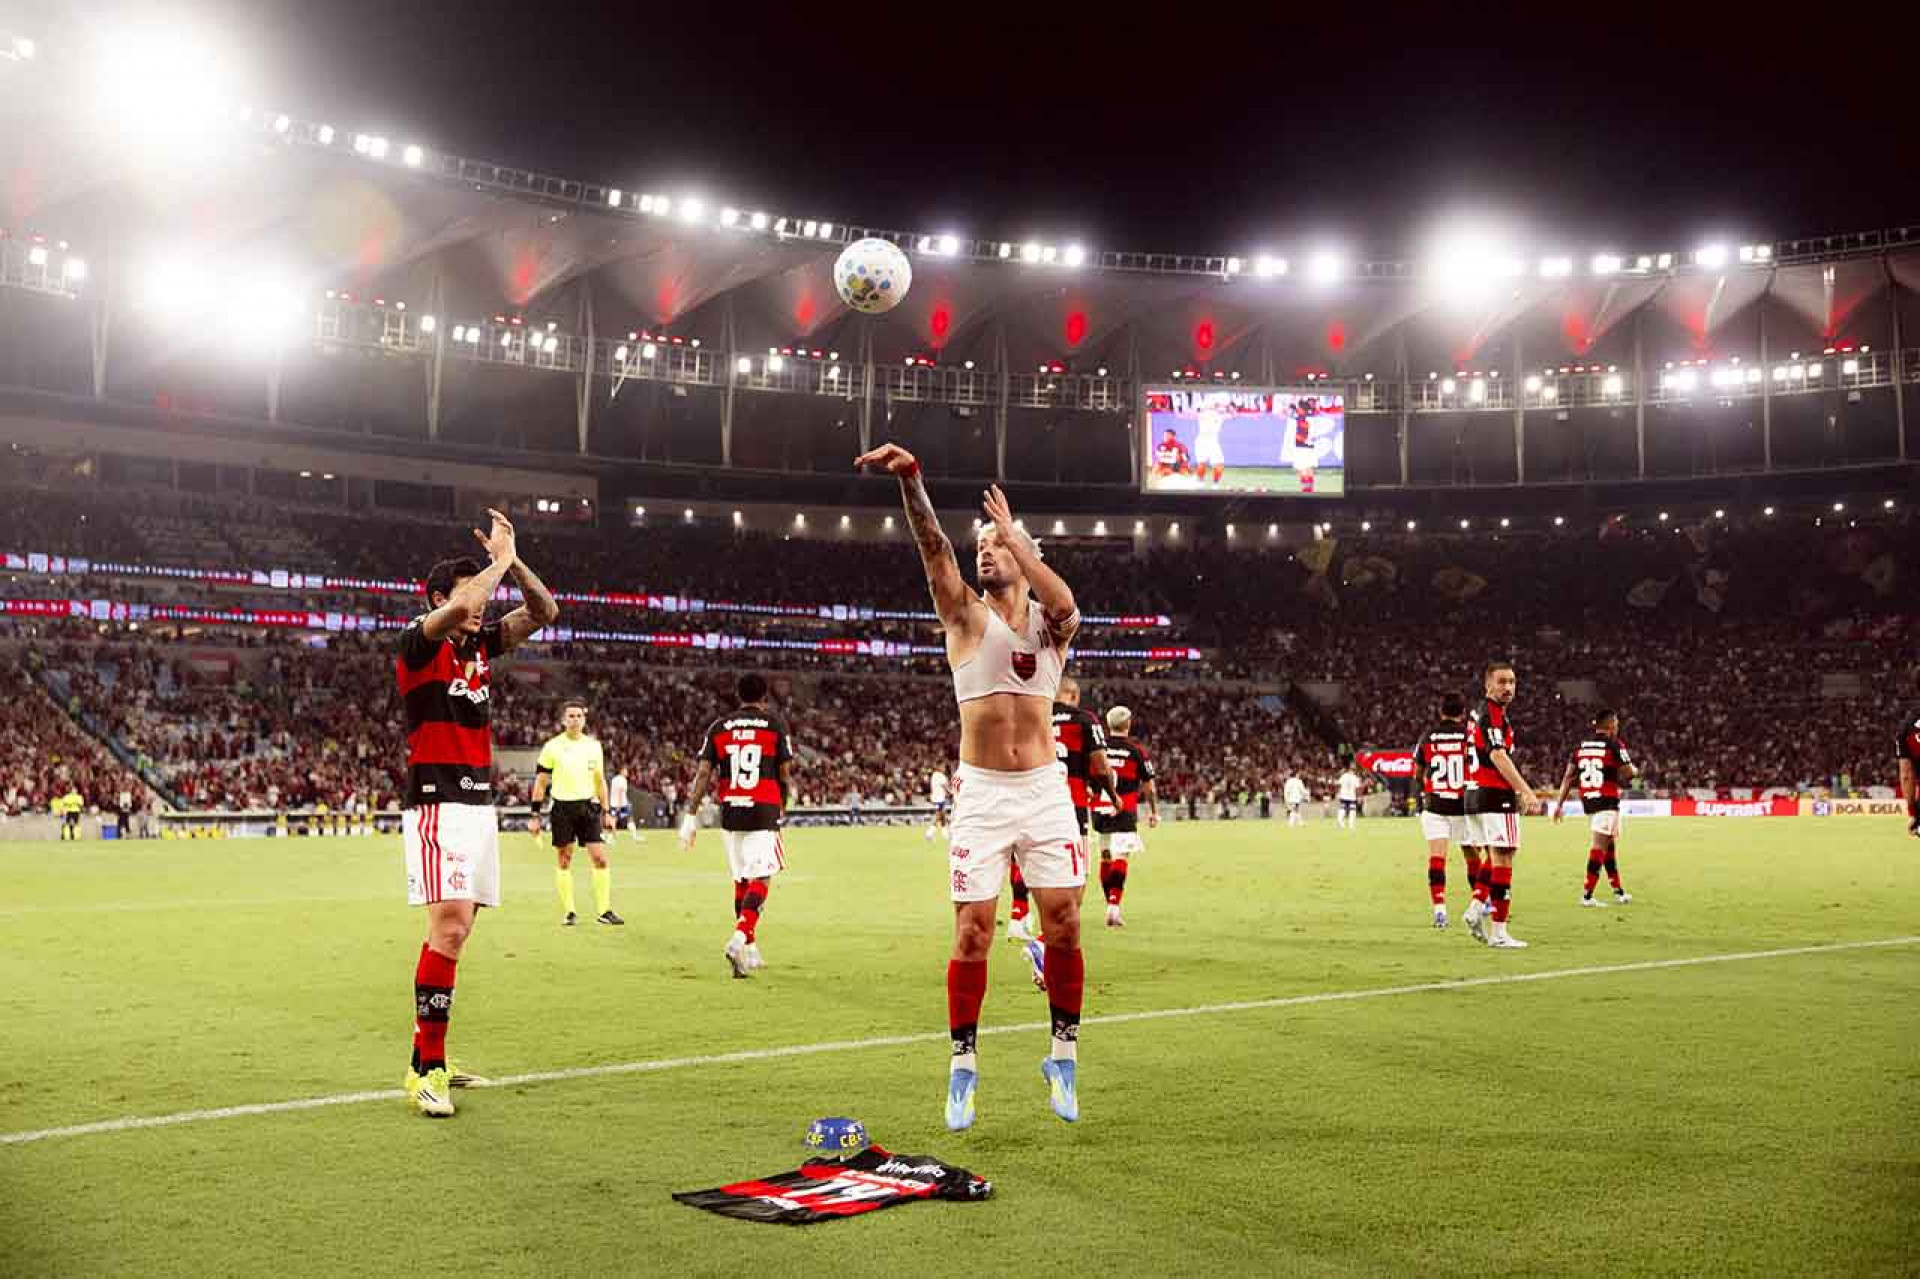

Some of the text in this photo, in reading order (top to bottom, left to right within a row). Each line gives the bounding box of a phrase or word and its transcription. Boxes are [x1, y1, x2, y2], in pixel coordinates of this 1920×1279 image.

[724, 743, 763, 790] 19
[1430, 754, 1465, 790] 20
[1578, 758, 1605, 789] 26
[1694, 801, 1774, 816] SUPERBET
[1835, 803, 1864, 815] BOA
[1868, 803, 1903, 815] IDEIA
